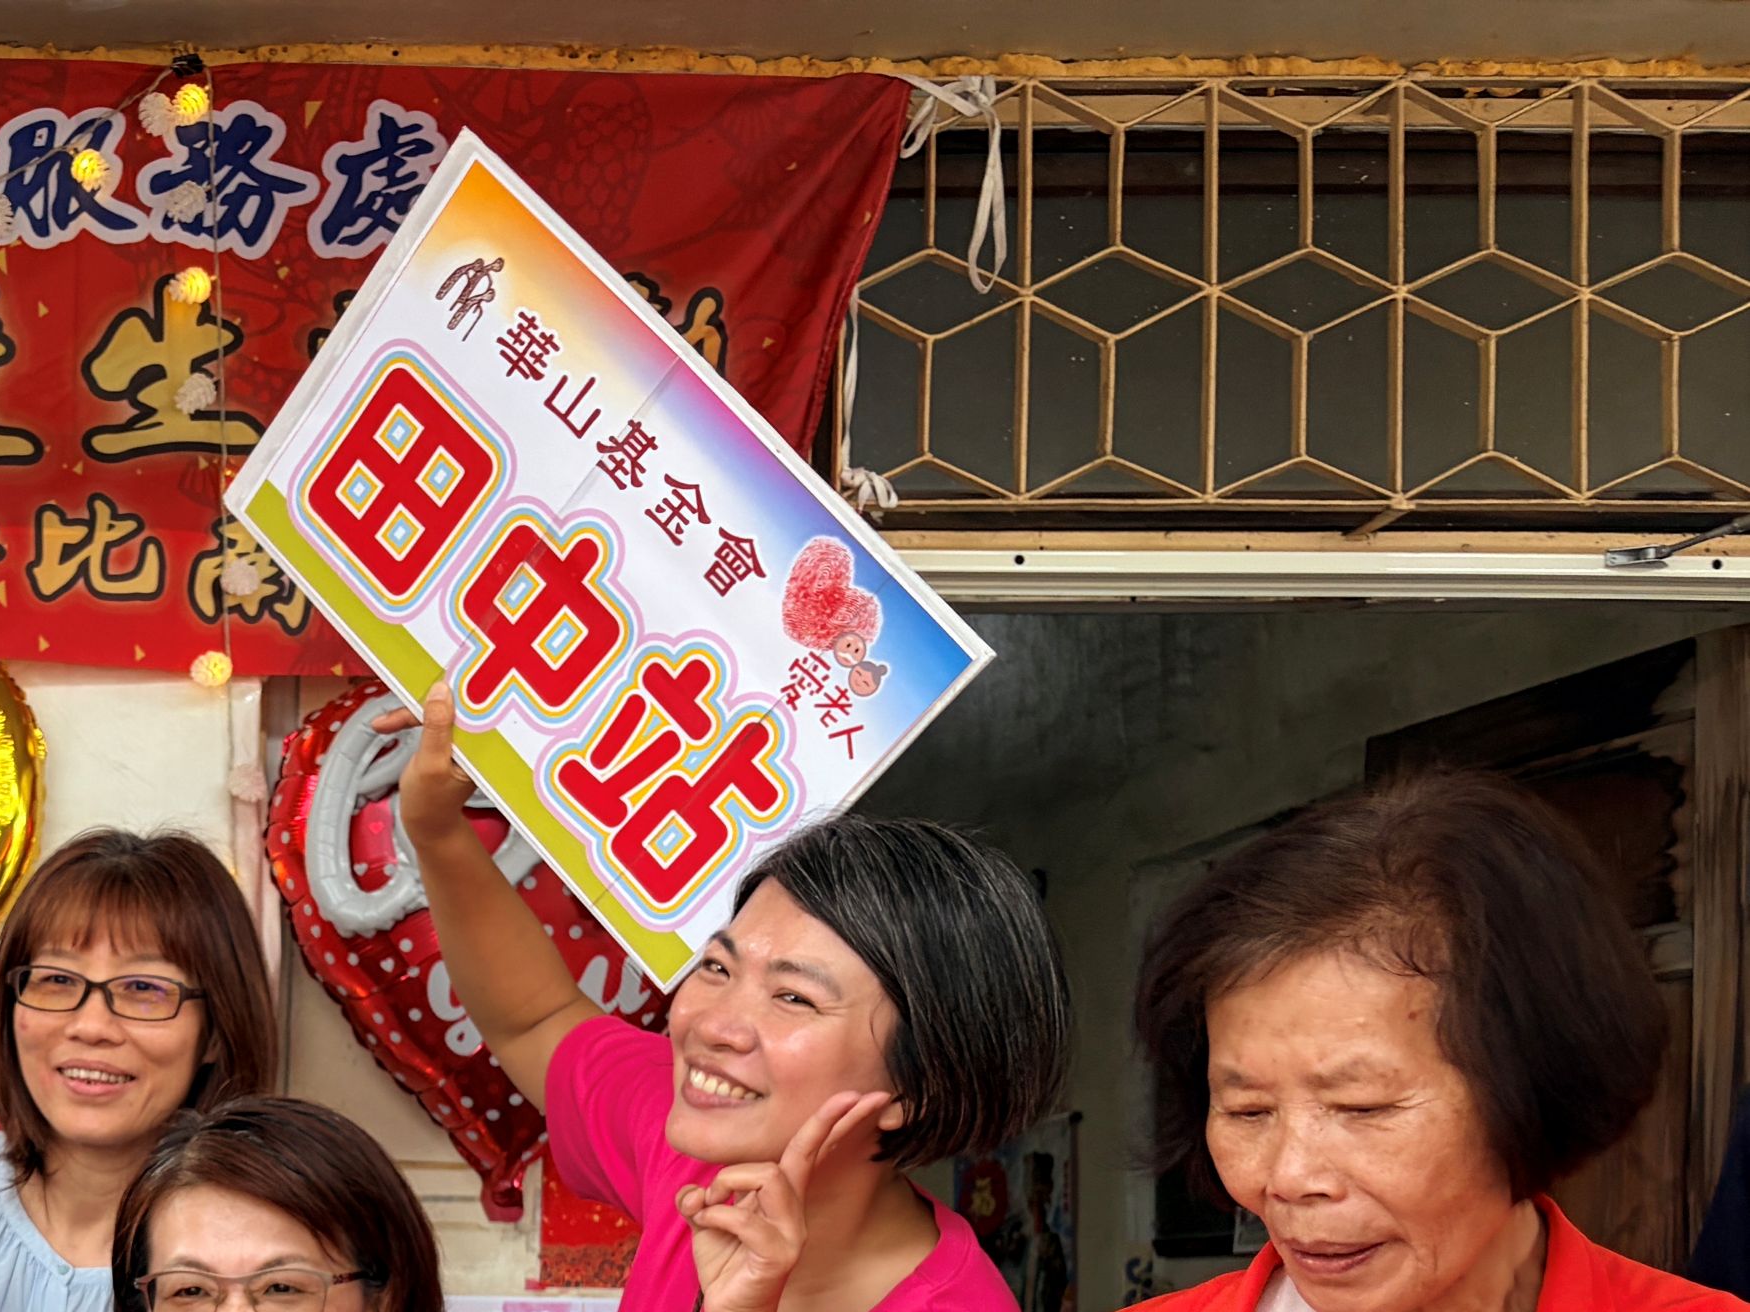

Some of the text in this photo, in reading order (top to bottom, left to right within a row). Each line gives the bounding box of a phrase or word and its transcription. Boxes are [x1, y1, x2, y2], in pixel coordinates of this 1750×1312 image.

[300, 360, 786, 914] 田中站
[496, 311, 768, 599] 華山基金會
